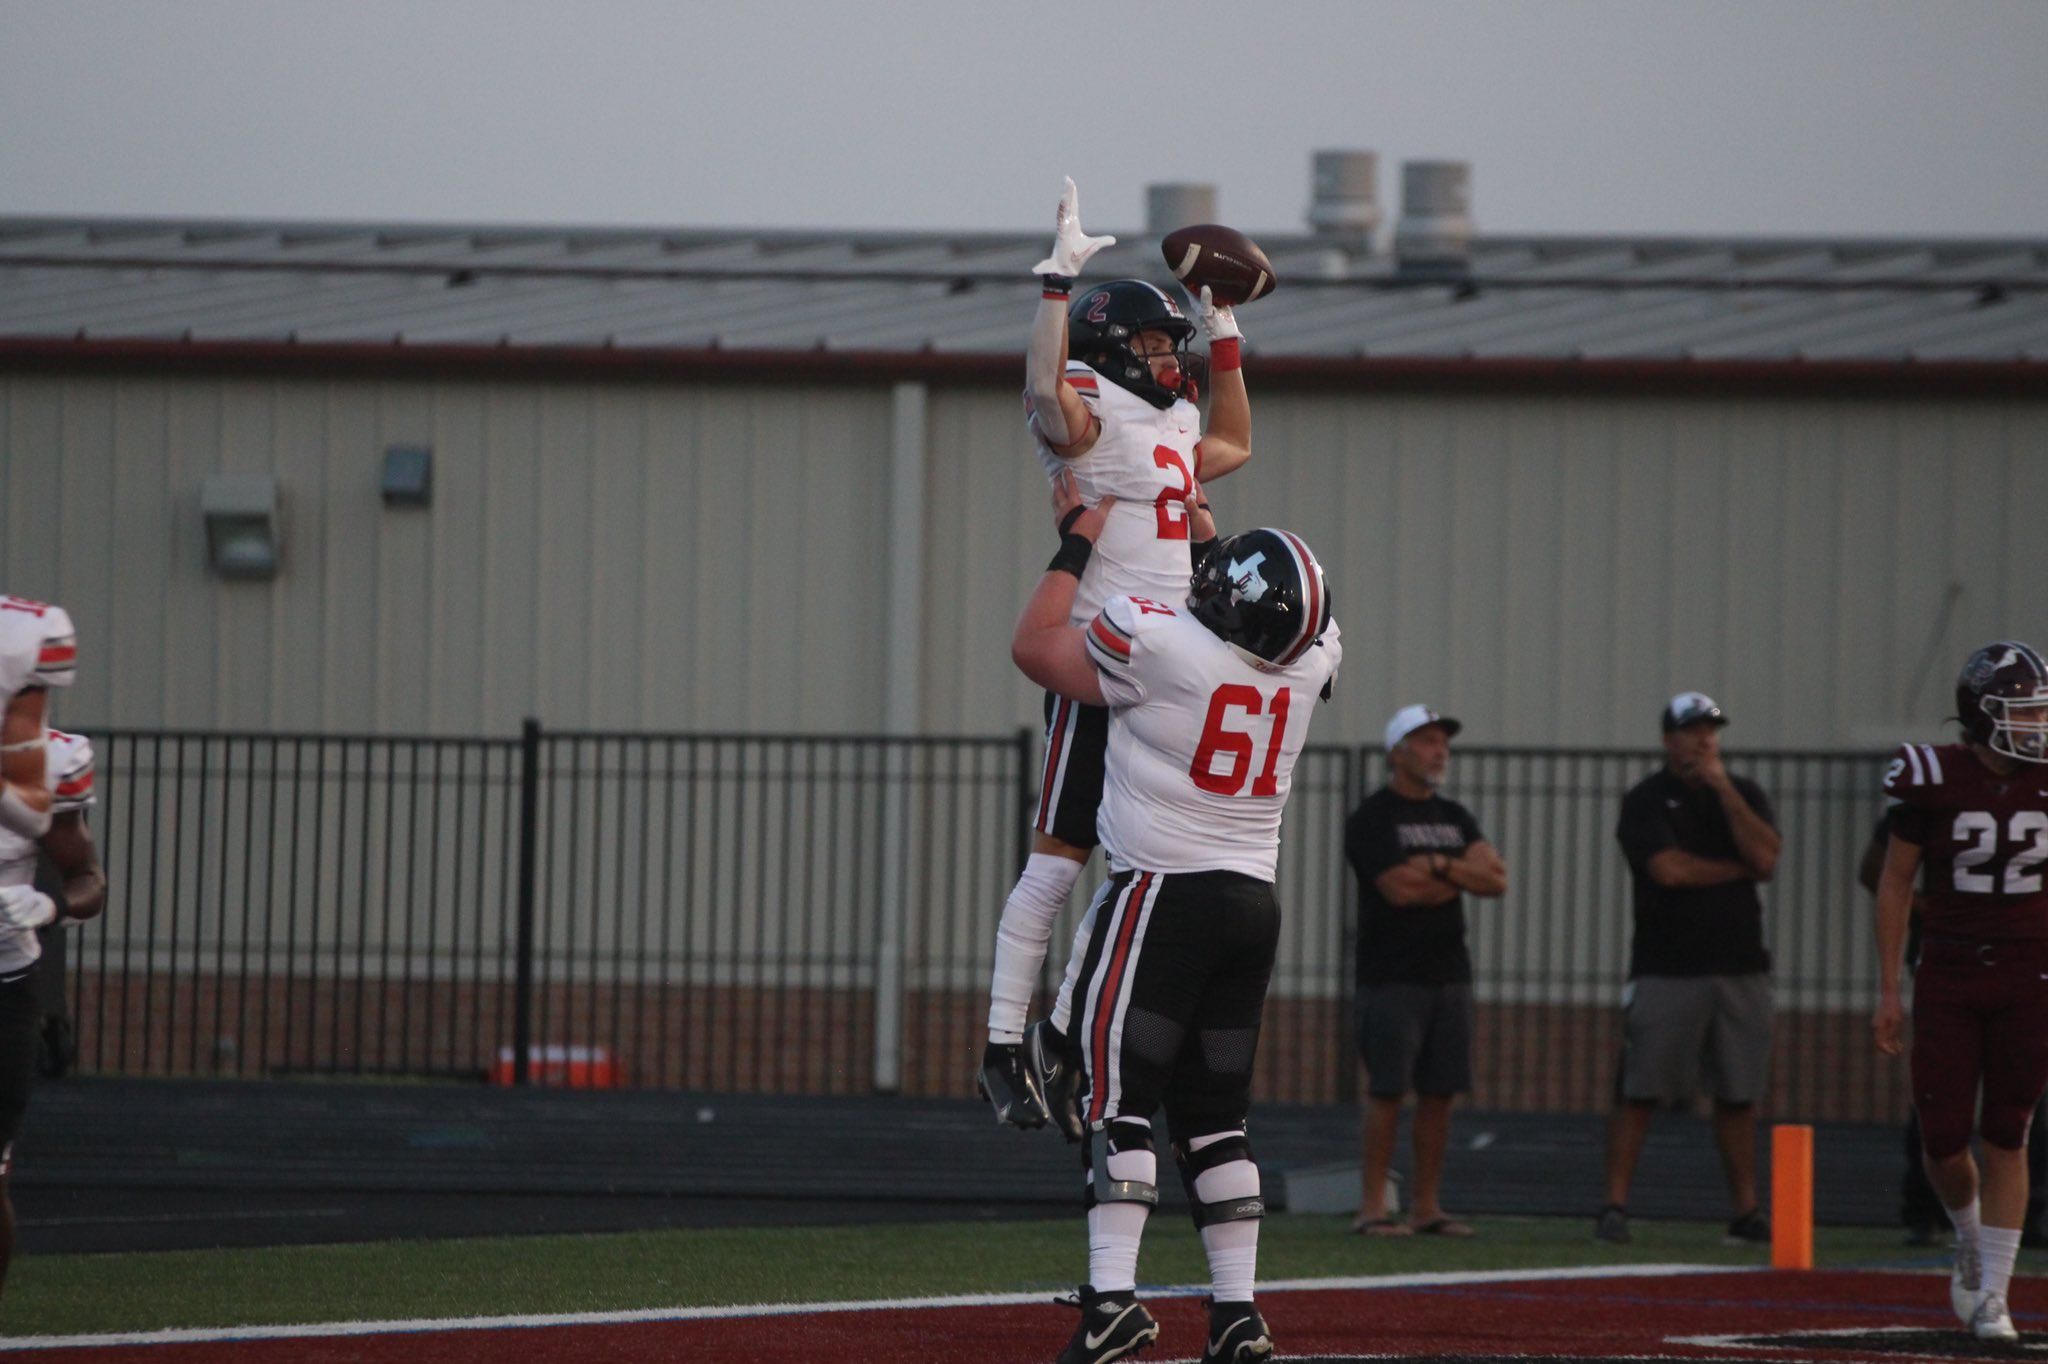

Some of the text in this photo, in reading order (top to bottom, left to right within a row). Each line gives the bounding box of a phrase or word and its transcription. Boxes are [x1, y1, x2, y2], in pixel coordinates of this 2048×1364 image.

[1088, 291, 1111, 323] 2
[1153, 444, 1193, 540] 2
[1189, 683, 1291, 797] 61
[1883, 757, 1906, 788] 2
[1952, 811, 2048, 894] 22
